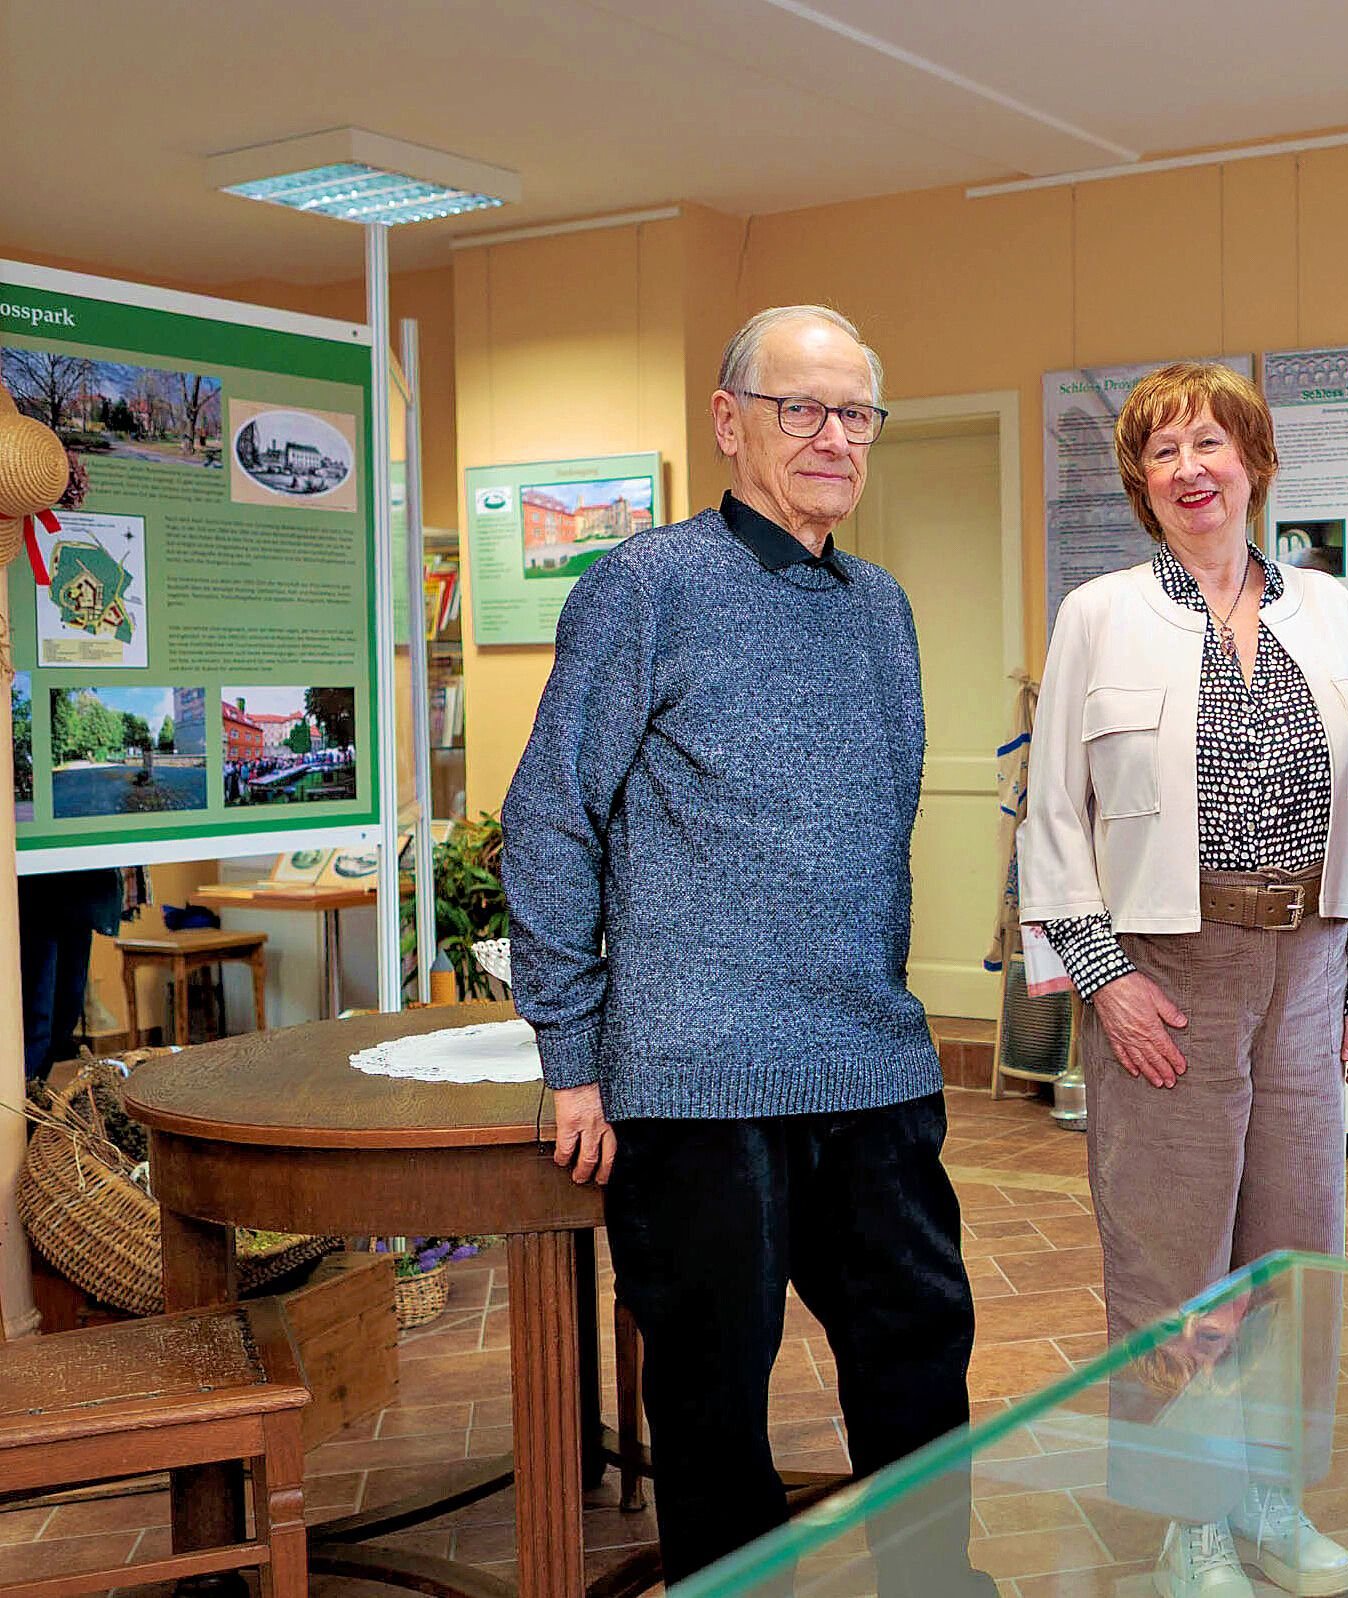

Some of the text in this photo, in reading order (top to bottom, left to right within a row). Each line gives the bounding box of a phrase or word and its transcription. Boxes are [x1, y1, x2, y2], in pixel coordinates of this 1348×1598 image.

[0, 303, 76, 326] osspark
[1104, 378, 1136, 393] Droy
[1301, 388, 1344, 400] Schloss
